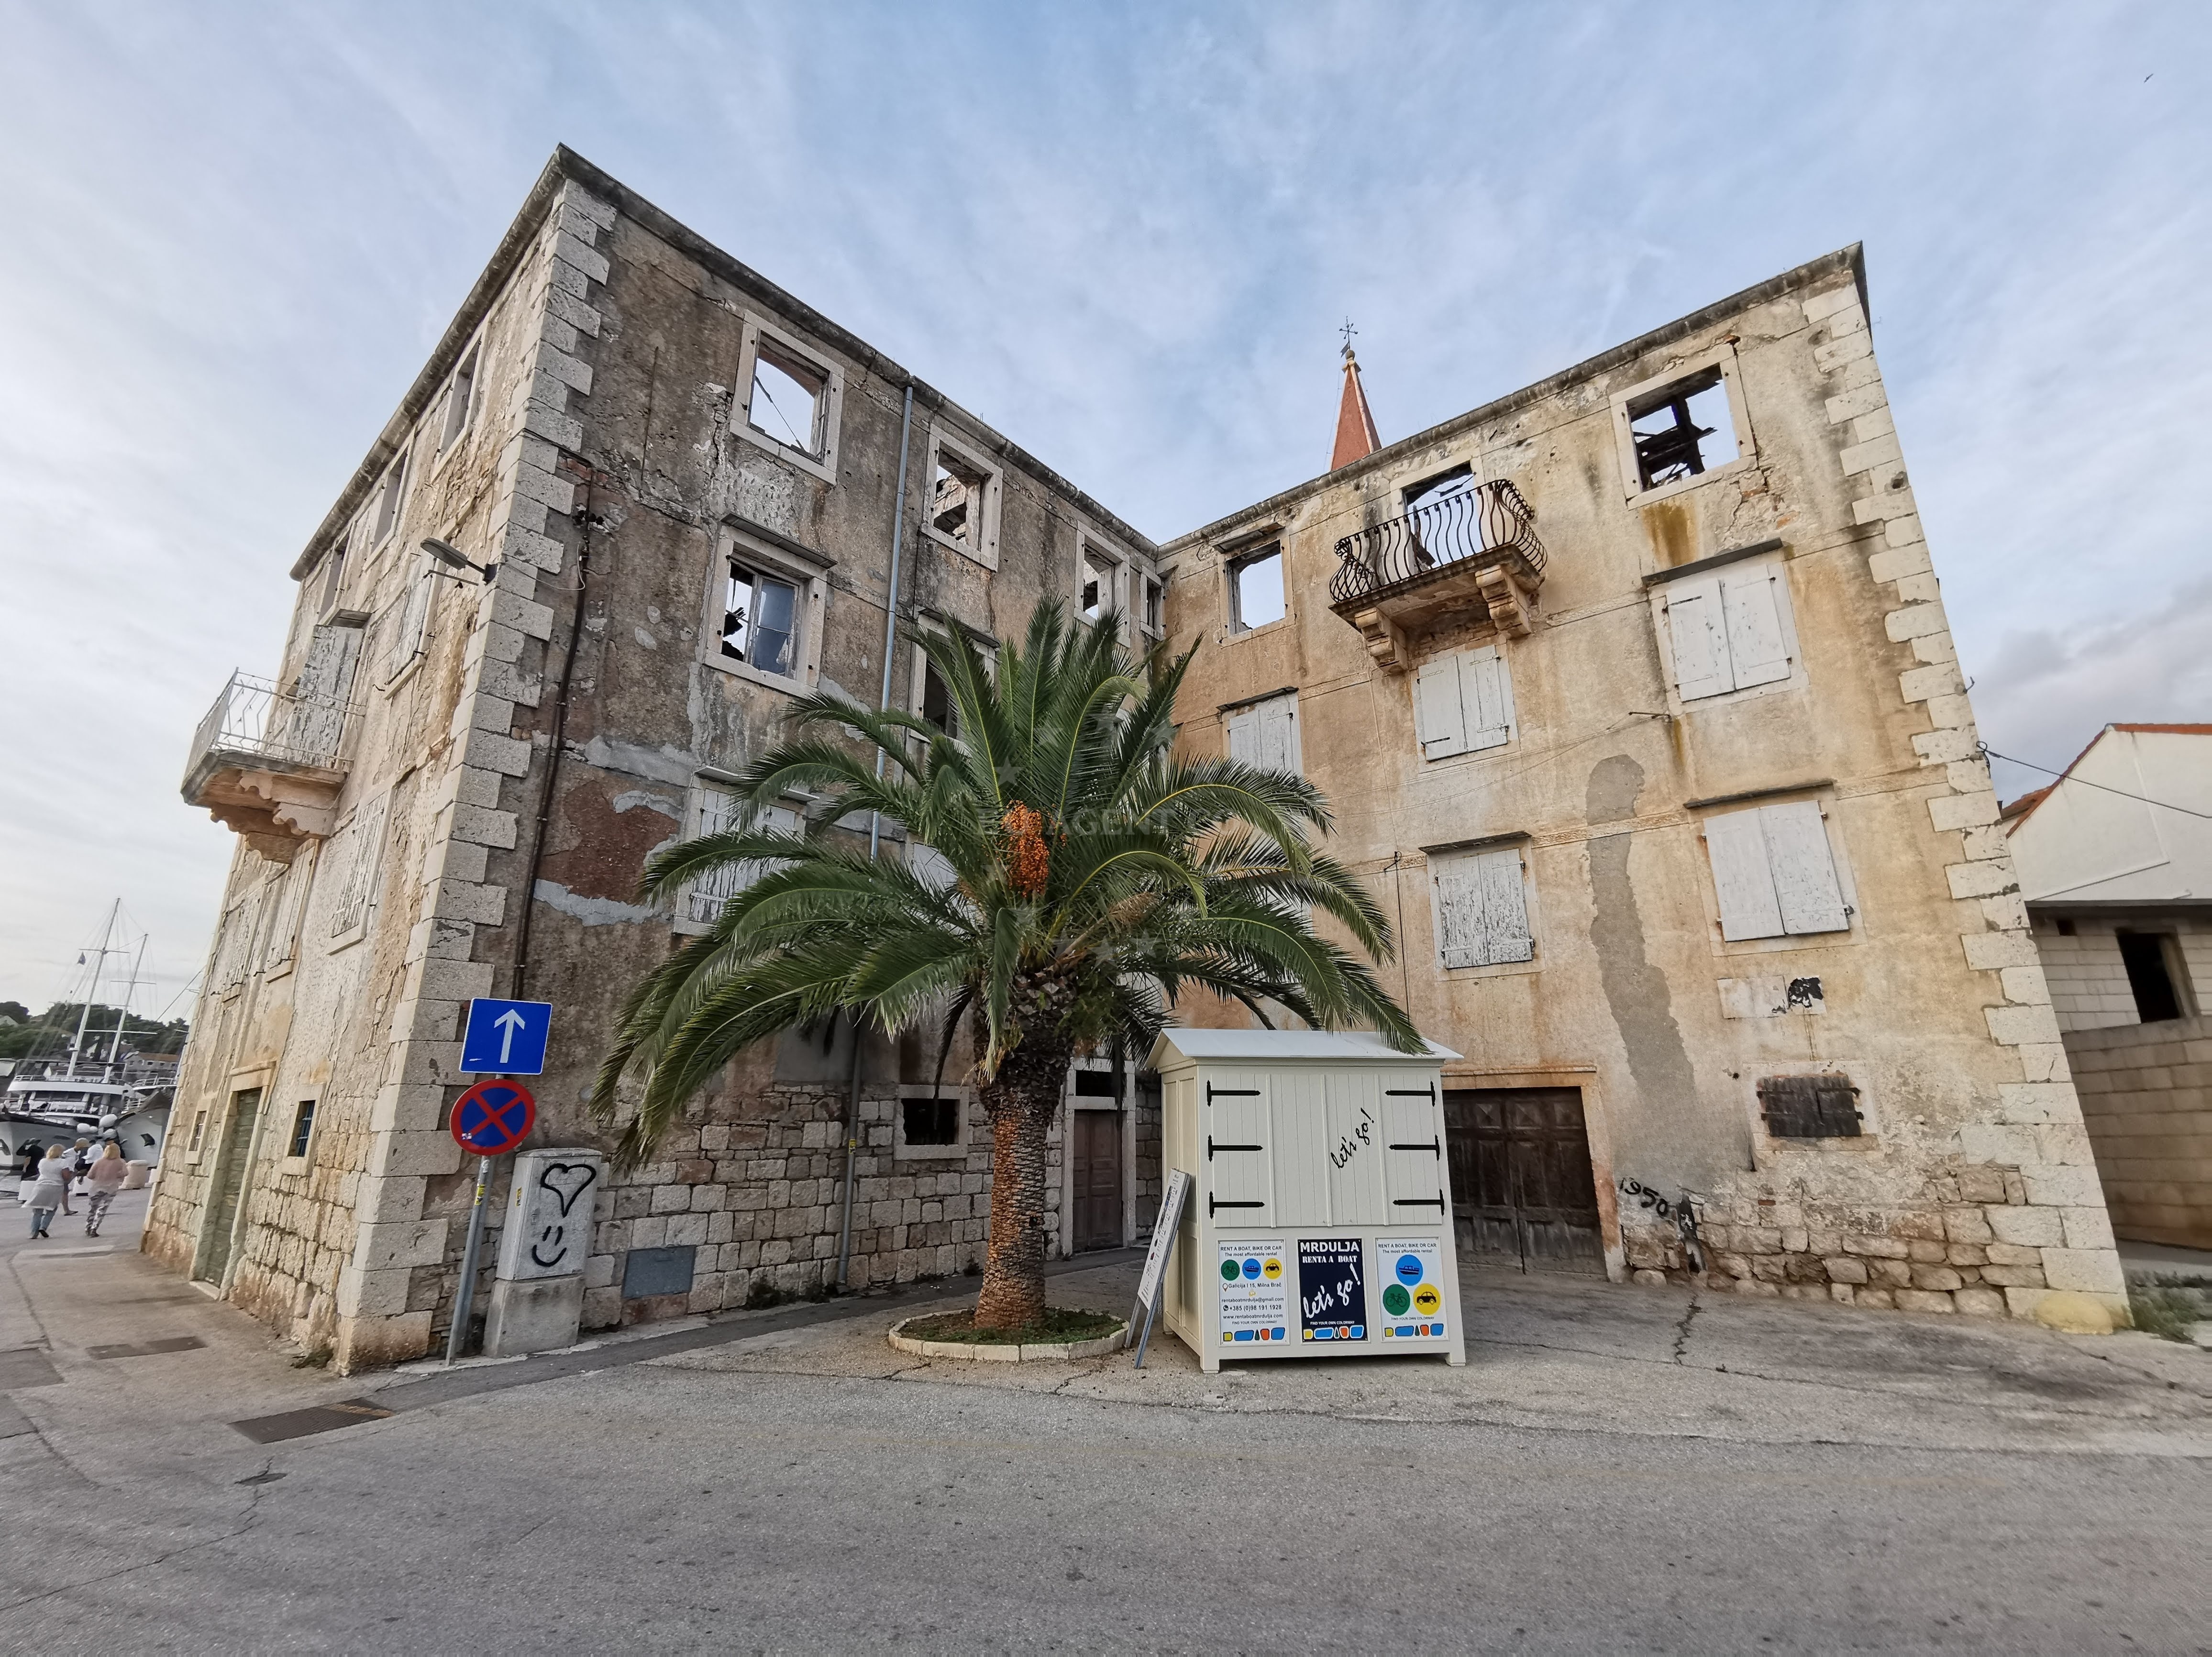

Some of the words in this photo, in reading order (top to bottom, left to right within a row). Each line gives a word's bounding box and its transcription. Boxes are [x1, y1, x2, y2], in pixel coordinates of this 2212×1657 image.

[1355, 1107, 1374, 1146] go!
[1300, 1241, 1360, 1252] MRDULJA
[1337, 1262, 1360, 1306] go!
